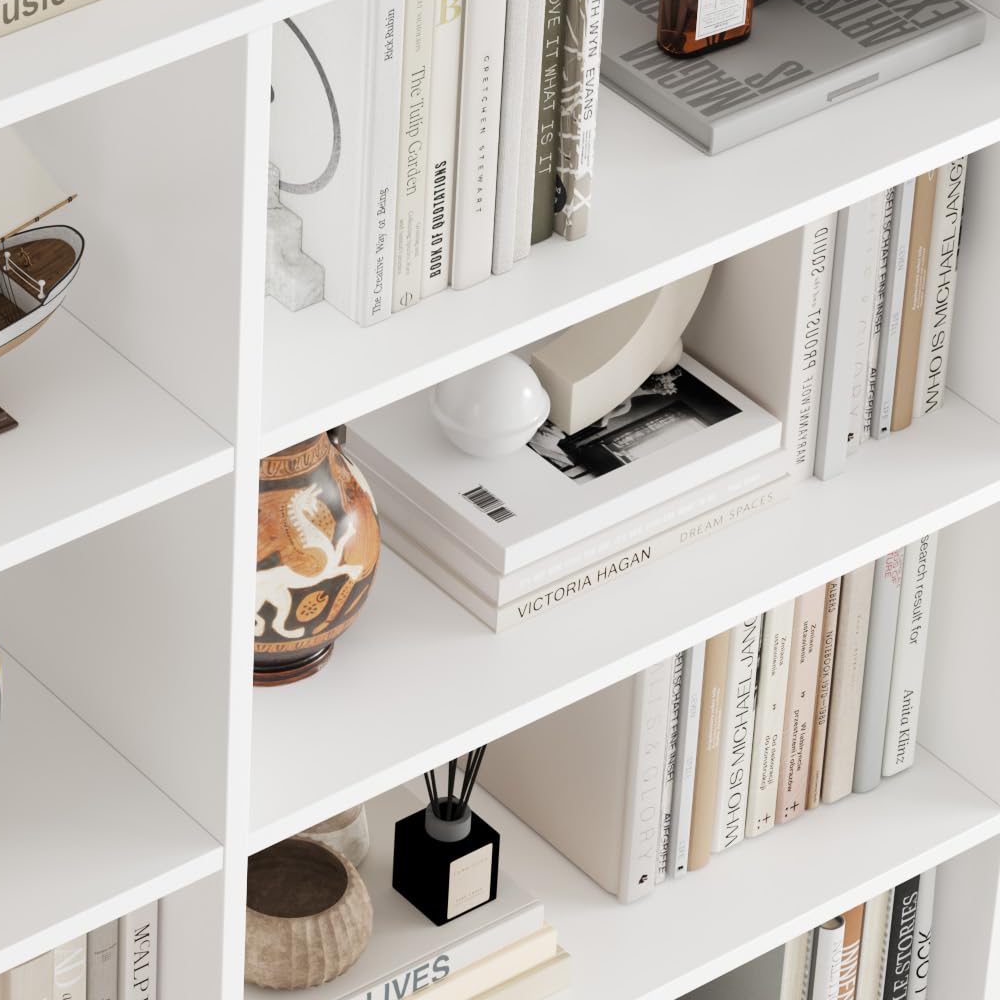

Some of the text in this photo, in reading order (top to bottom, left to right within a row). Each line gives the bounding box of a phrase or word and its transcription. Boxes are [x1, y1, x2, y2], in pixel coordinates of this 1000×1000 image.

[384, 8, 396, 62] Rick Rubin
[545, 35, 559, 58] IT
[587, 20, 600, 57] WYN
[411, 65, 427, 98] The
[543, 63, 557, 111] WHAT
[583, 68, 596, 121] EVANS
[406, 99, 422, 138] Tulip
[476, 54, 491, 215] GRETCHEN STEWART
[540, 119, 554, 145] IS
[406, 140, 424, 197] Garden
[538, 151, 552, 175] IT
[377, 187, 389, 216] Being
[430, 161, 447, 278] BOOK OF QUOTATIONS
[376, 233, 387, 256] Way
[374, 257, 385, 291] Creative
[935, 224, 958, 327] MICHAEL
[372, 292, 382, 315] The
[932, 329, 945, 352] IS
[926, 355, 942, 413] WHO
[517, 492, 774, 618] VICTORIA HAGAN DREAM SPACES
[828, 583, 838, 613] ALBERS
[913, 584, 926, 619] result
[908, 621, 920, 646] for
[823, 631, 833, 679] NOTEBOOK
[732, 671, 752, 765] MICHAEL
[896, 689, 914, 765] Anita Klinz
[730, 769, 744, 792] IS
[723, 793, 742, 847] WHO
[895, 891, 918, 974] STORIES
